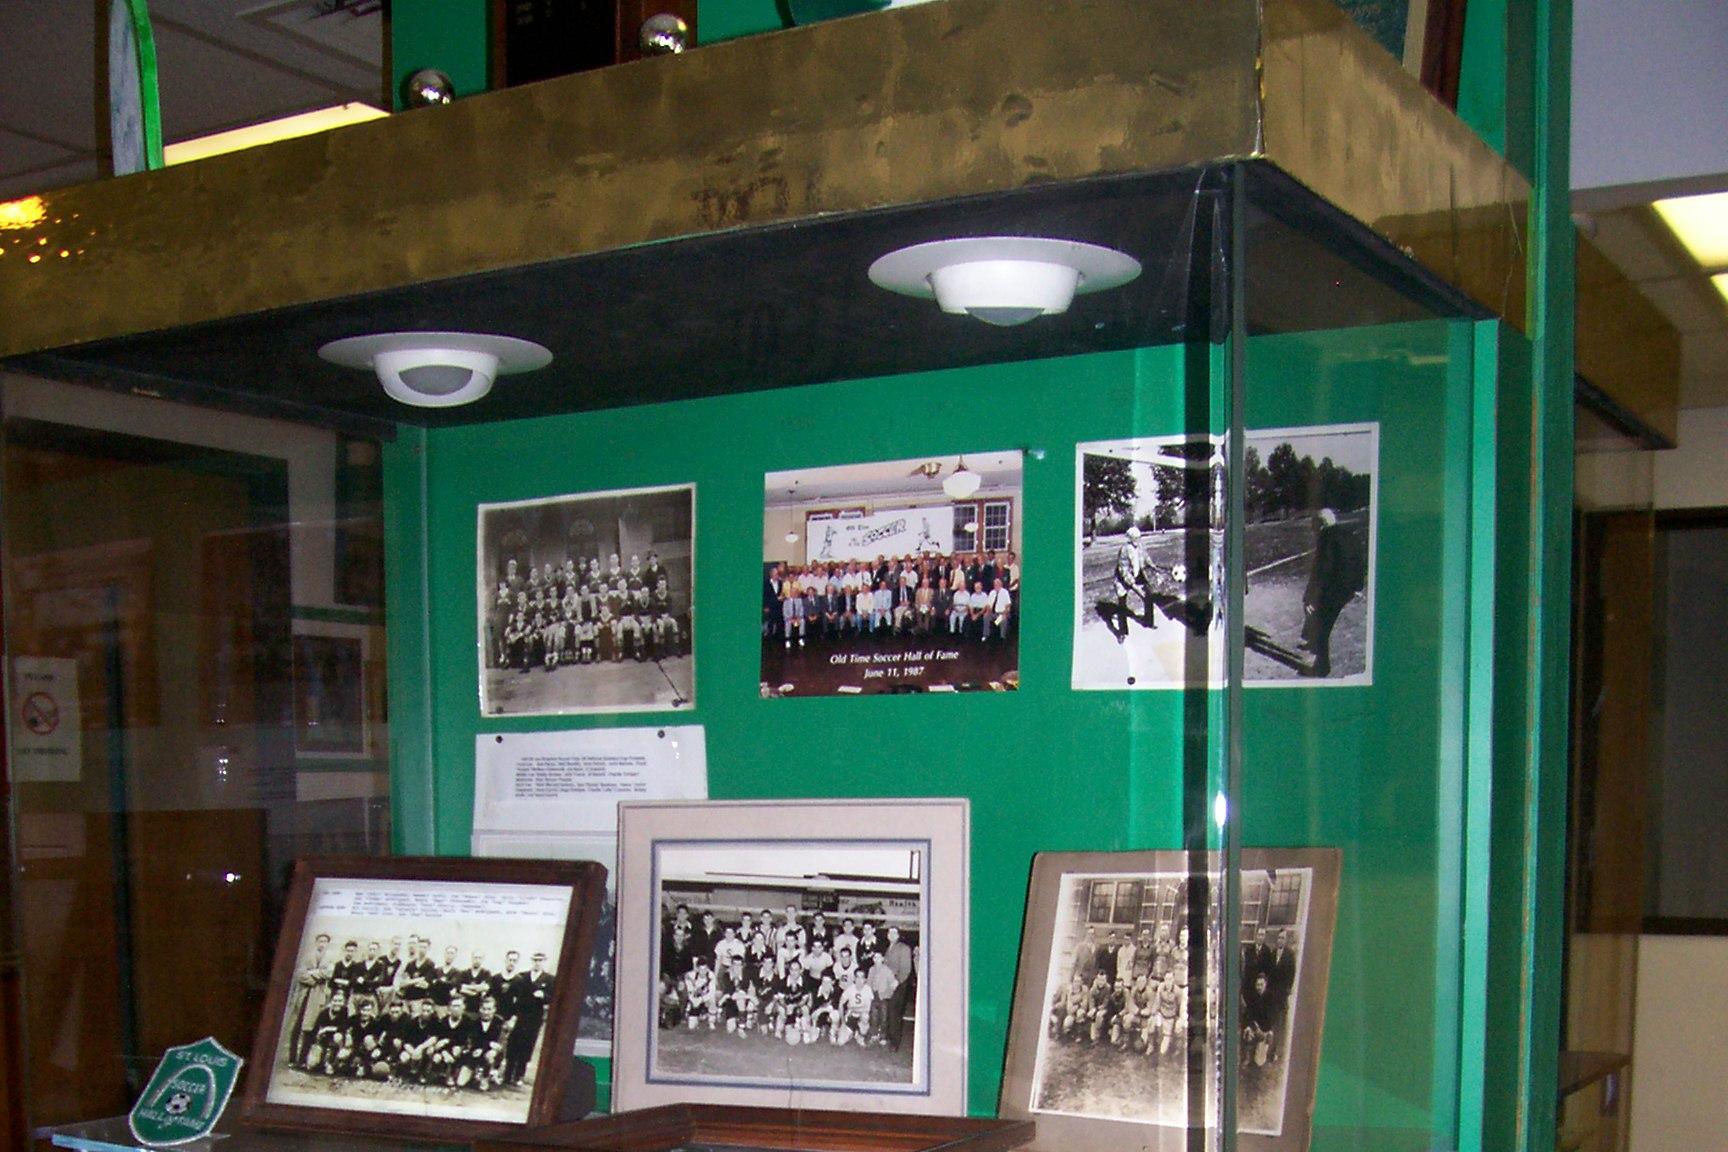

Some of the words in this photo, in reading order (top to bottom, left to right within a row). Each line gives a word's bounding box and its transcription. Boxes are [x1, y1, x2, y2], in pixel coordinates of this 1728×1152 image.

[829, 653, 847, 664] Old
[850, 653, 870, 664] Time
[873, 652, 901, 663] Soccer
[903, 650, 922, 661] Hall
[923, 650, 934, 661] of
[936, 650, 960, 660] Fame
[863, 667, 884, 679] June
[887, 667, 899, 678] 11,
[903, 666, 925, 676] 1987
[193, 1053, 228, 1067] LOUIS
